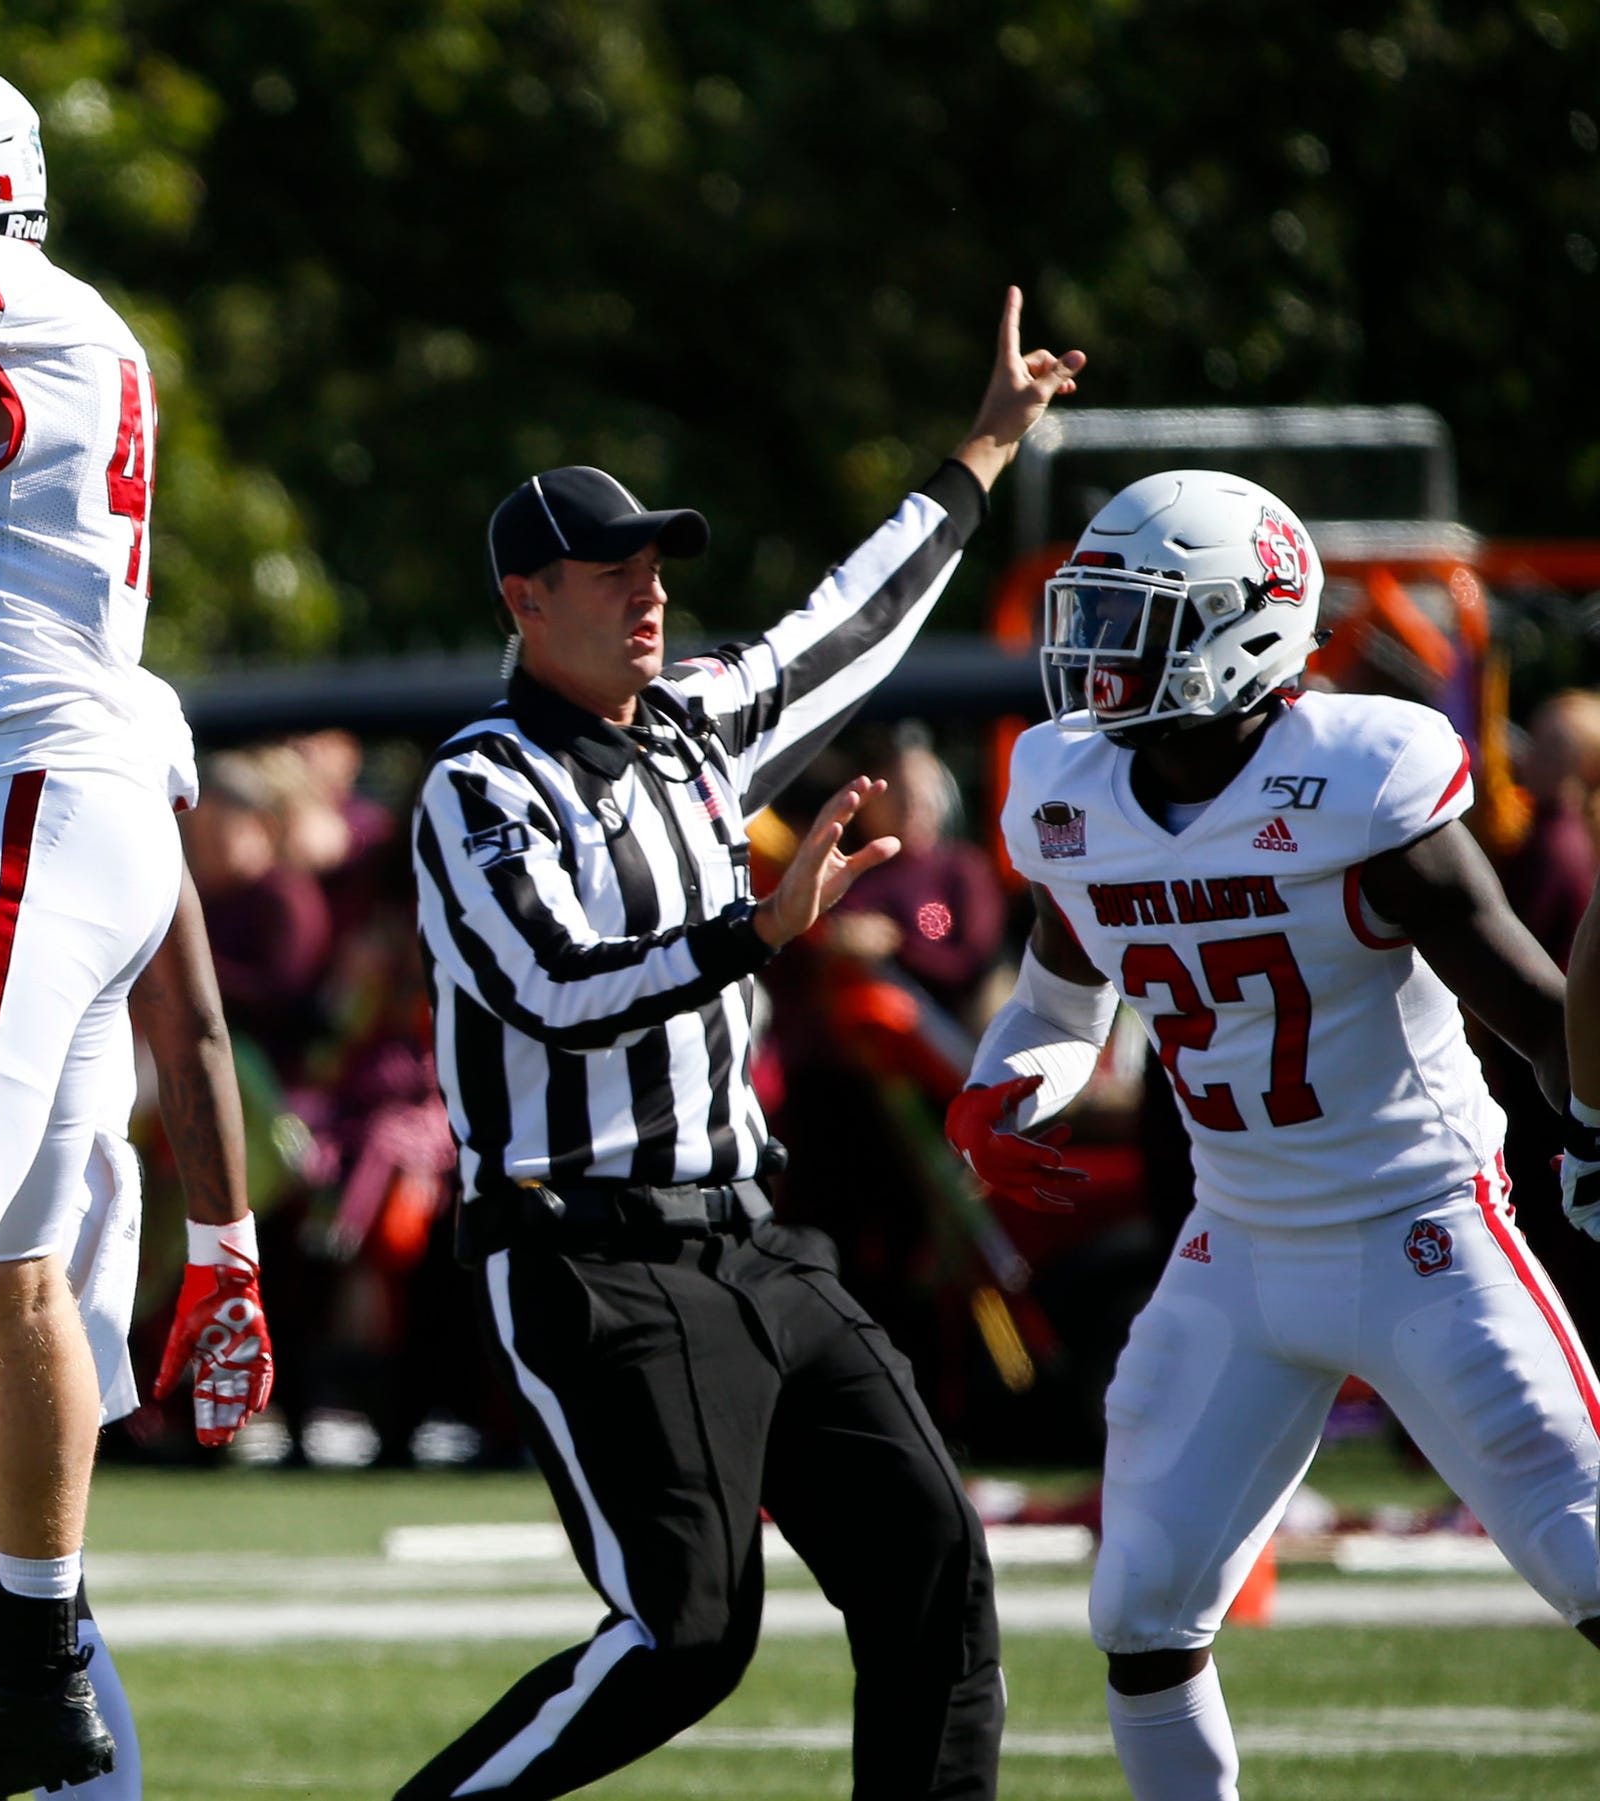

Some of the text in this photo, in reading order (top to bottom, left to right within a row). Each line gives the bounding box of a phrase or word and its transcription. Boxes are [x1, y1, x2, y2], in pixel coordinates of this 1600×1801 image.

[1253, 838, 1298, 853] adidas
[1087, 875, 1290, 927] SOUTH DAKOTA
[1120, 931, 1325, 1132] 27
